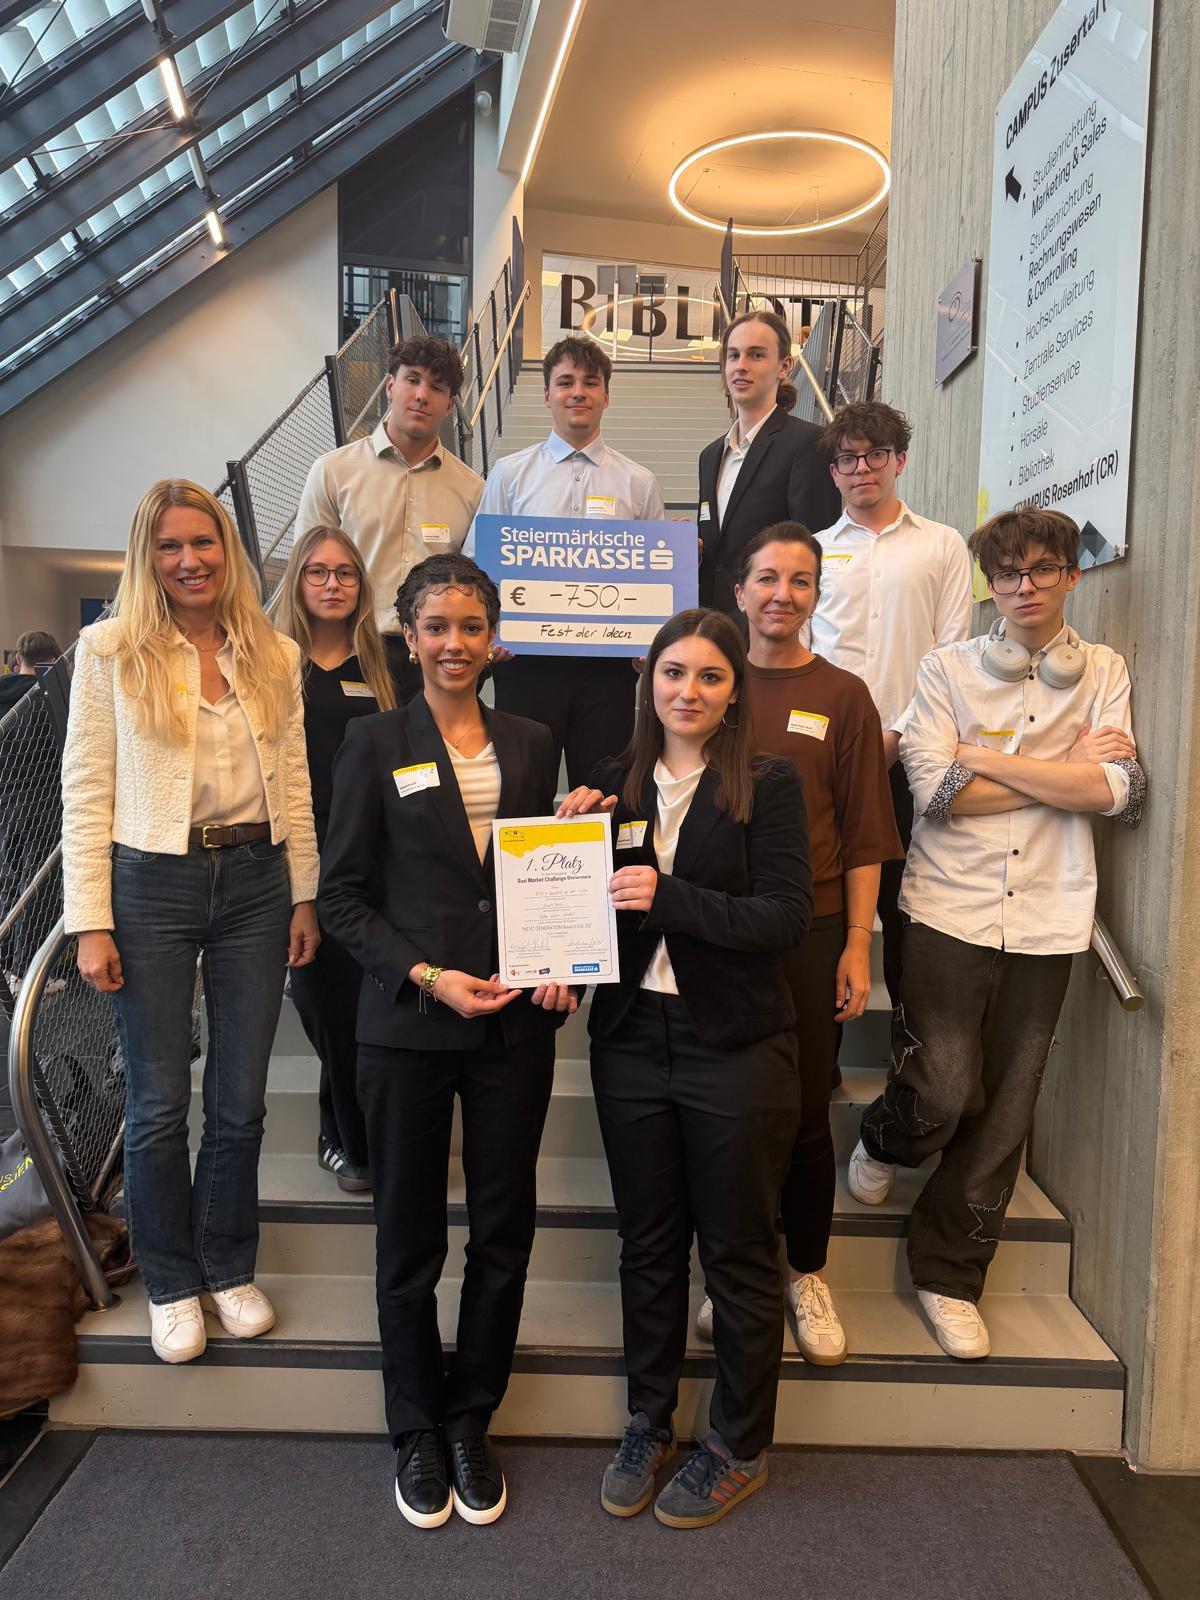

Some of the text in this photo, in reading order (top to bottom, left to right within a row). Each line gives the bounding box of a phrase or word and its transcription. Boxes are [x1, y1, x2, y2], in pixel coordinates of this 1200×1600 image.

[1006, 0, 1100, 149] CAMPUS Zusertal
[1031, 117, 1107, 218] Marketing & Sales
[1032, 100, 1097, 191] Studienrichtung
[1028, 193, 1101, 281] Rechnungswesen
[1029, 172, 1094, 254] Studienrichtung
[1027, 248, 1077, 307] & Controlling
[1025, 269, 1094, 344] Hochschulleitung
[1023, 310, 1093, 380] Zentrale Services
[1022, 360, 1080, 415] Studienservice
[1020, 418, 1048, 450] Hörsäle
[1018, 448, 1055, 486] Bibliothek
[1051, 463, 1094, 504] Rosenhof
[1096, 449, 1119, 486] (CR)
[500, 545, 645, 570] SPARKASSE
[501, 527, 645, 547] Steiermärkische
[510, 586, 526, 606] €
[540, 624, 632, 639] Fest der Ideen
[526, 853, 583, 874] 1. Platz
